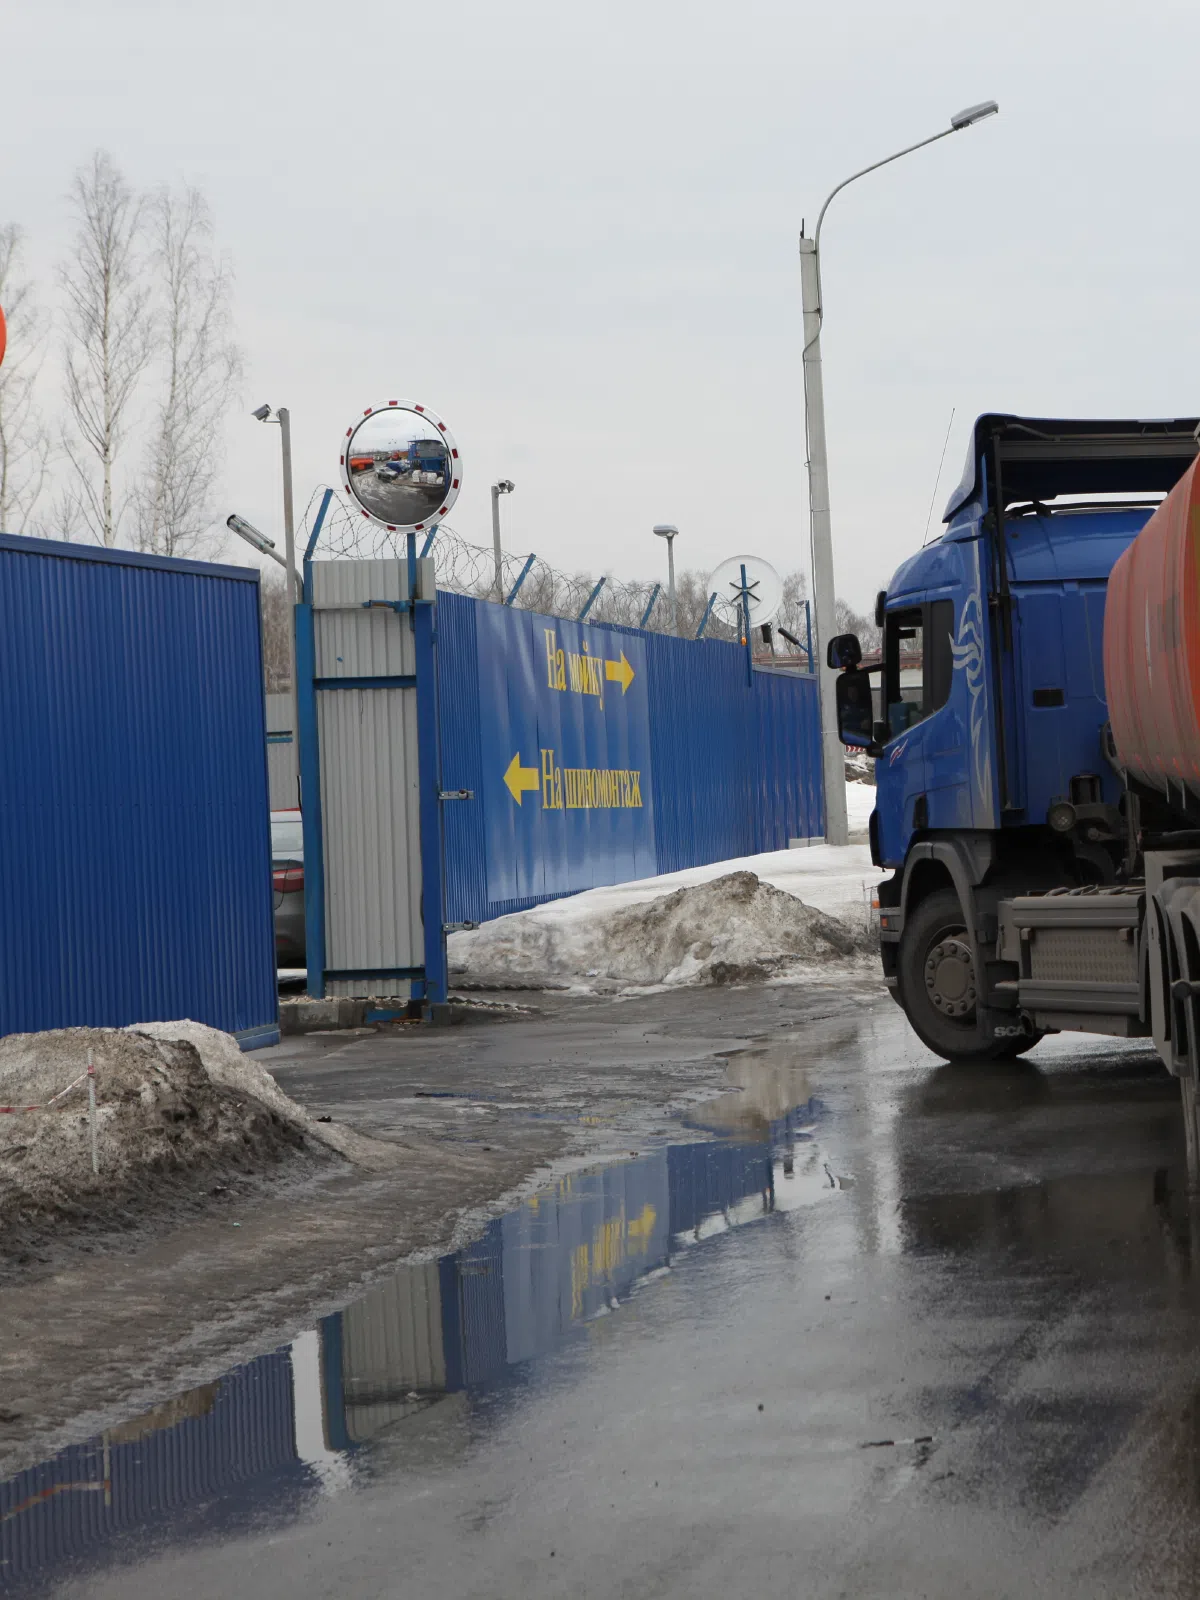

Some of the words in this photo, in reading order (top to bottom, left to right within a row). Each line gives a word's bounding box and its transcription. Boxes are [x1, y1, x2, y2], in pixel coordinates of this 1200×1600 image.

[543, 628, 567, 692] На
[568, 640, 604, 711] мойку
[540, 749, 563, 809] На
[564, 768, 643, 809] шиномонтаж
[994, 1025, 1026, 1037] SCA
